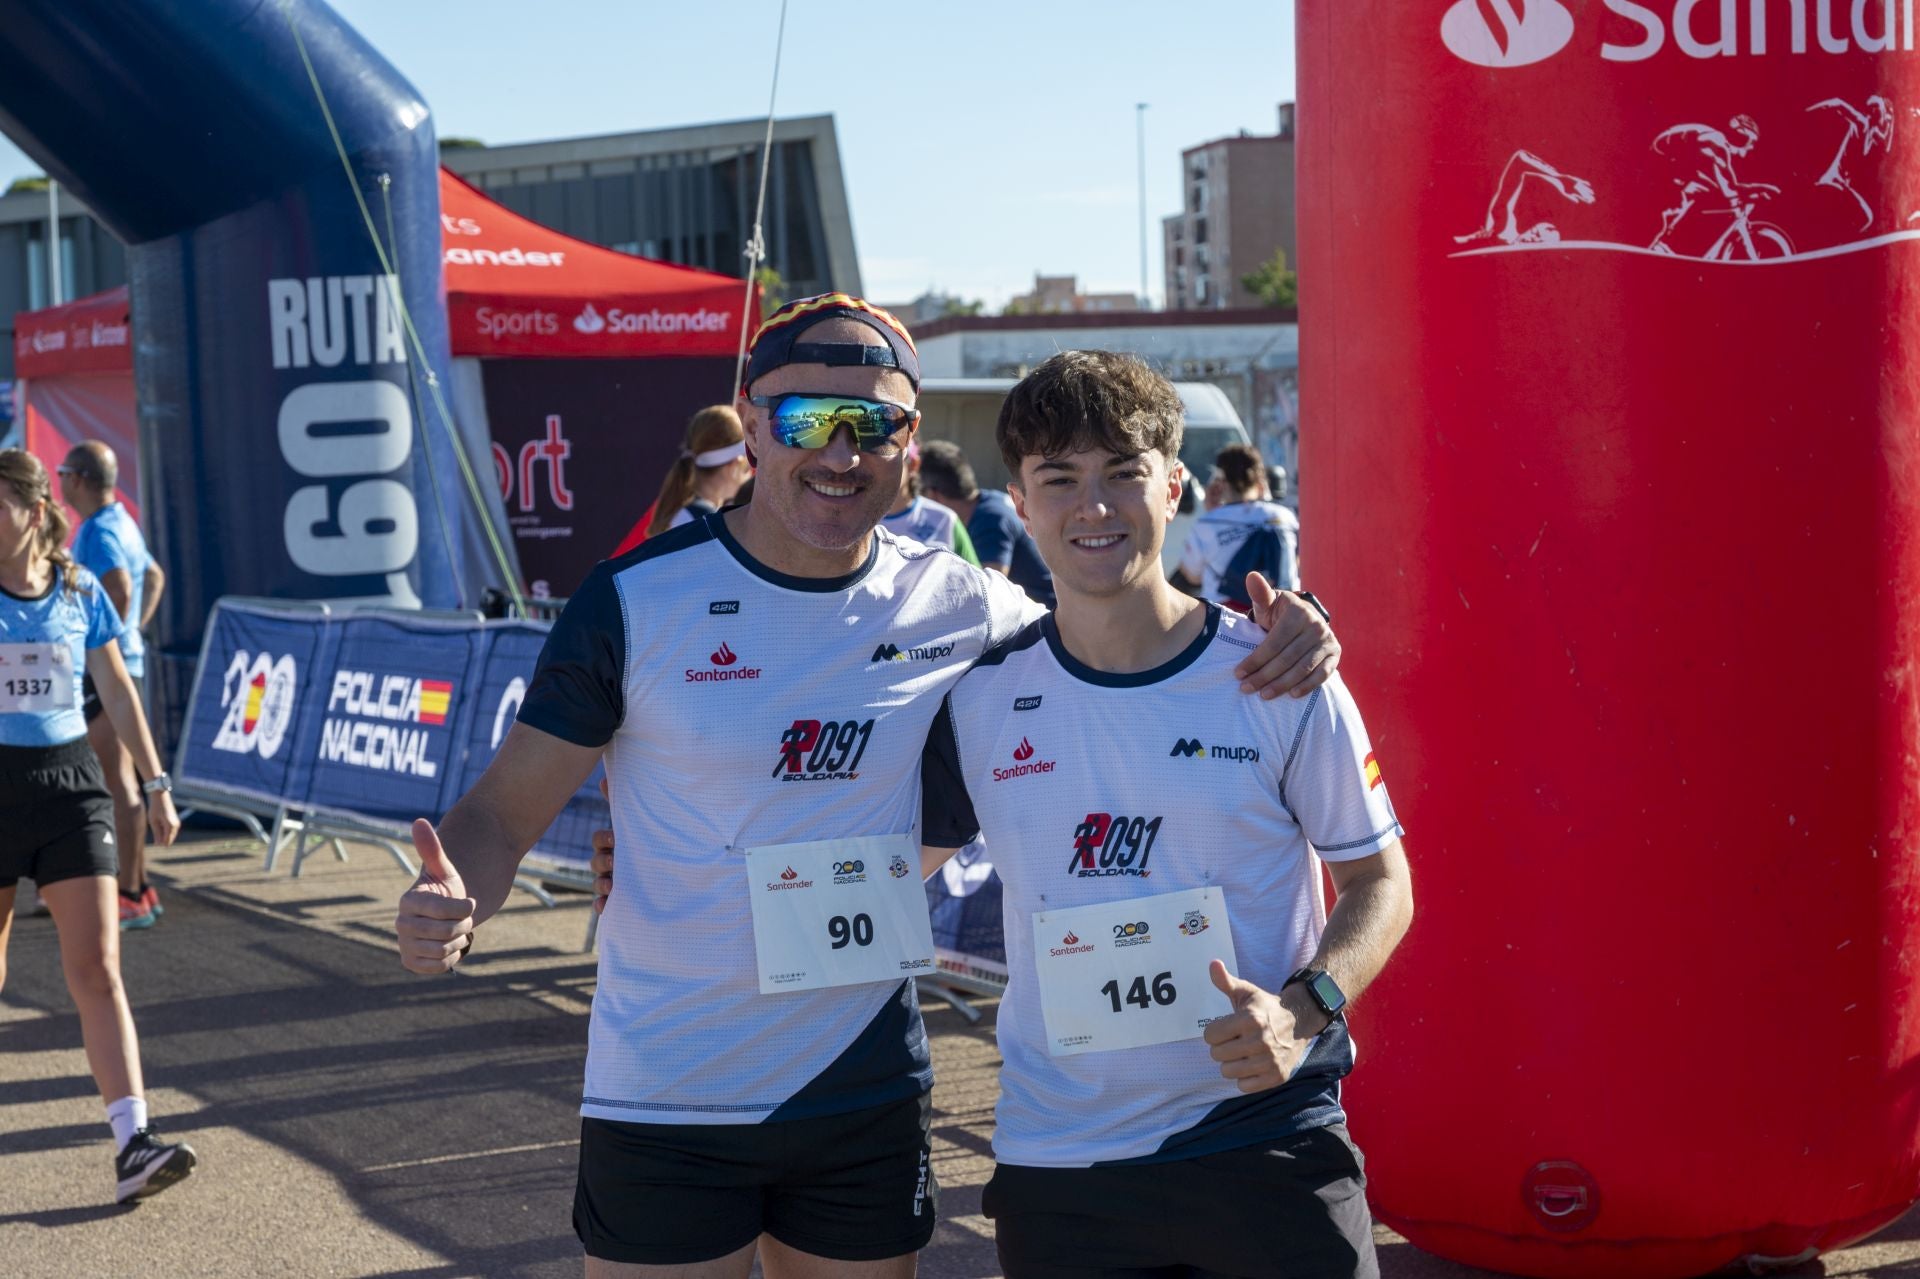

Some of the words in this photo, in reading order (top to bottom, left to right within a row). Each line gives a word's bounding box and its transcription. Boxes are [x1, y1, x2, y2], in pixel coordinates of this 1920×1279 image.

[442, 248, 565, 267] ander
[268, 274, 407, 369] RUTA
[476, 307, 559, 340] Sports
[607, 308, 731, 334] Santander
[711, 603, 737, 612] 42K
[909, 642, 955, 662] mupol
[685, 666, 762, 682] Santander
[5, 679, 52, 696] 1337
[329, 670, 421, 722] POLICIA
[1016, 699, 1039, 708] 42K
[319, 718, 437, 777] NACIONAL
[1212, 746, 1259, 763] mupol
[782, 772, 853, 782] SOLIDARIA
[993, 760, 1056, 781] Santander
[833, 860, 864, 875] 200
[1077, 868, 1145, 878] SOLIDARIA
[767, 880, 813, 891] Santander
[828, 913, 873, 950] 90
[1113, 921, 1149, 938] 200
[1050, 944, 1095, 956] Santander
[1101, 971, 1177, 1013] 146
